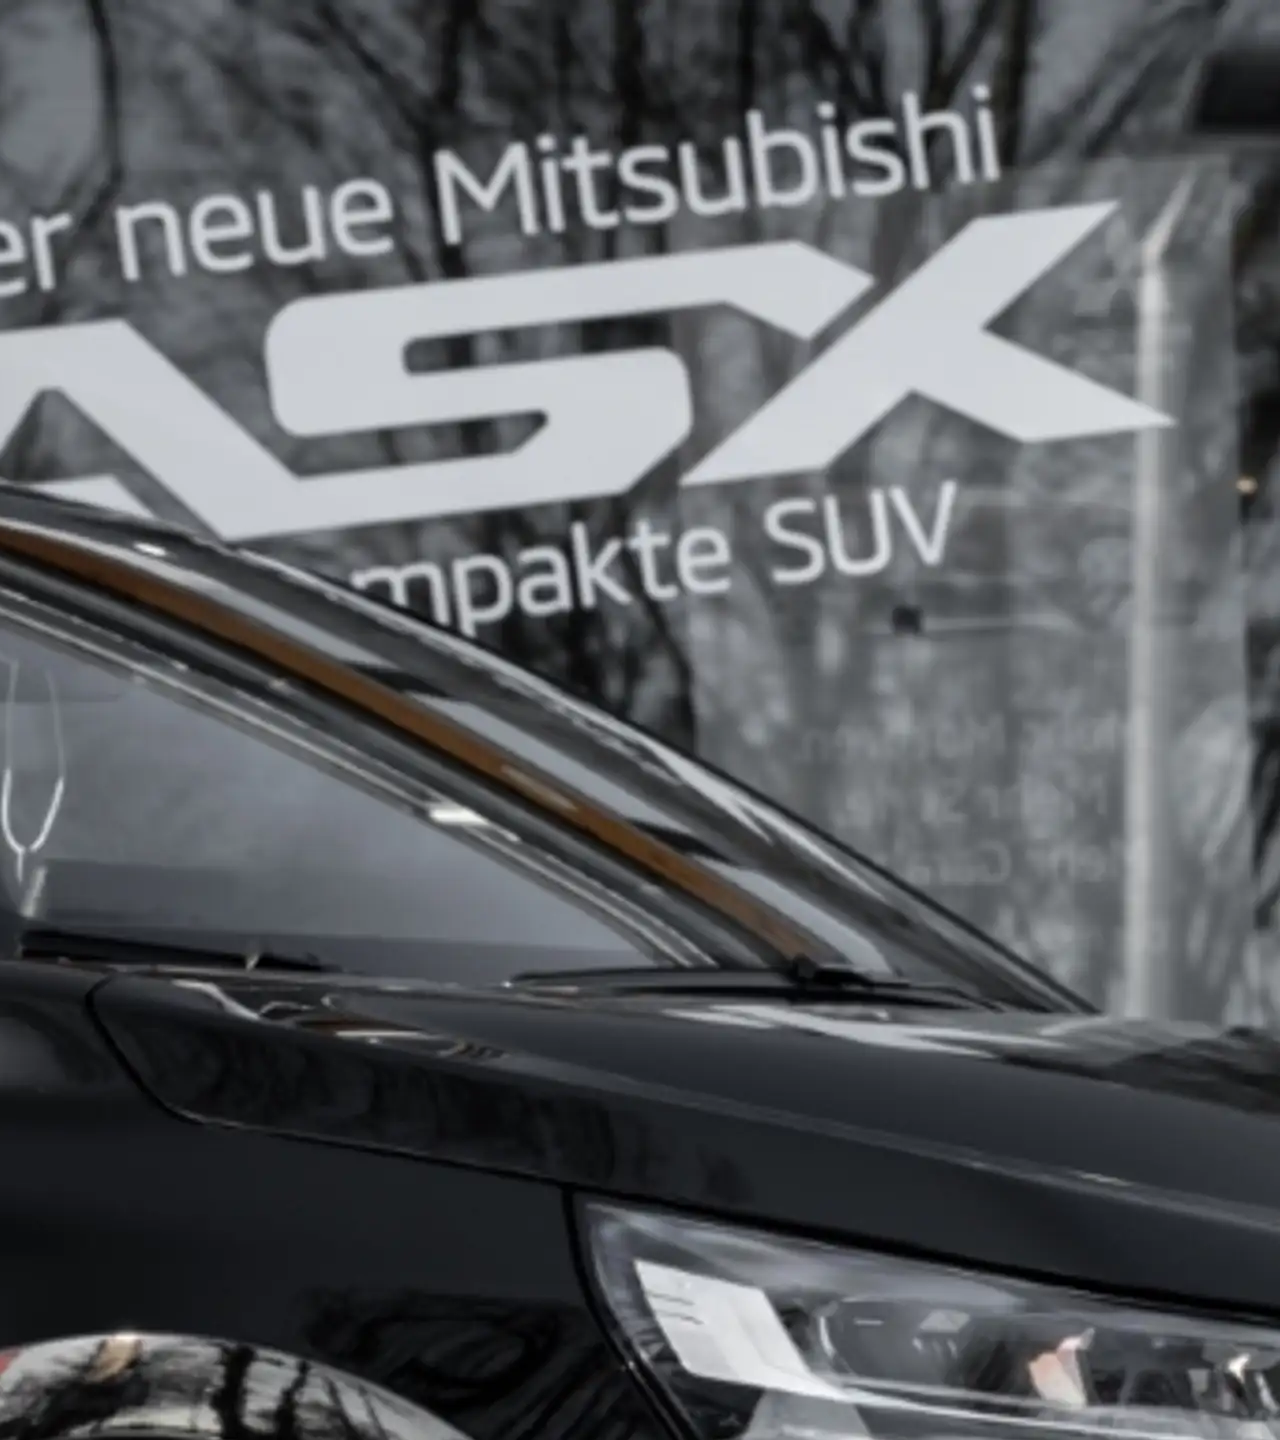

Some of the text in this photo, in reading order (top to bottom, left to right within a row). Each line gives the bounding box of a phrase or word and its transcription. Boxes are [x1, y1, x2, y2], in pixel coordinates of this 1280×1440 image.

[115, 177, 395, 283] neue
[432, 82, 1002, 246] Mitsubishi
[350, 479, 957, 637] mpakte SUV
